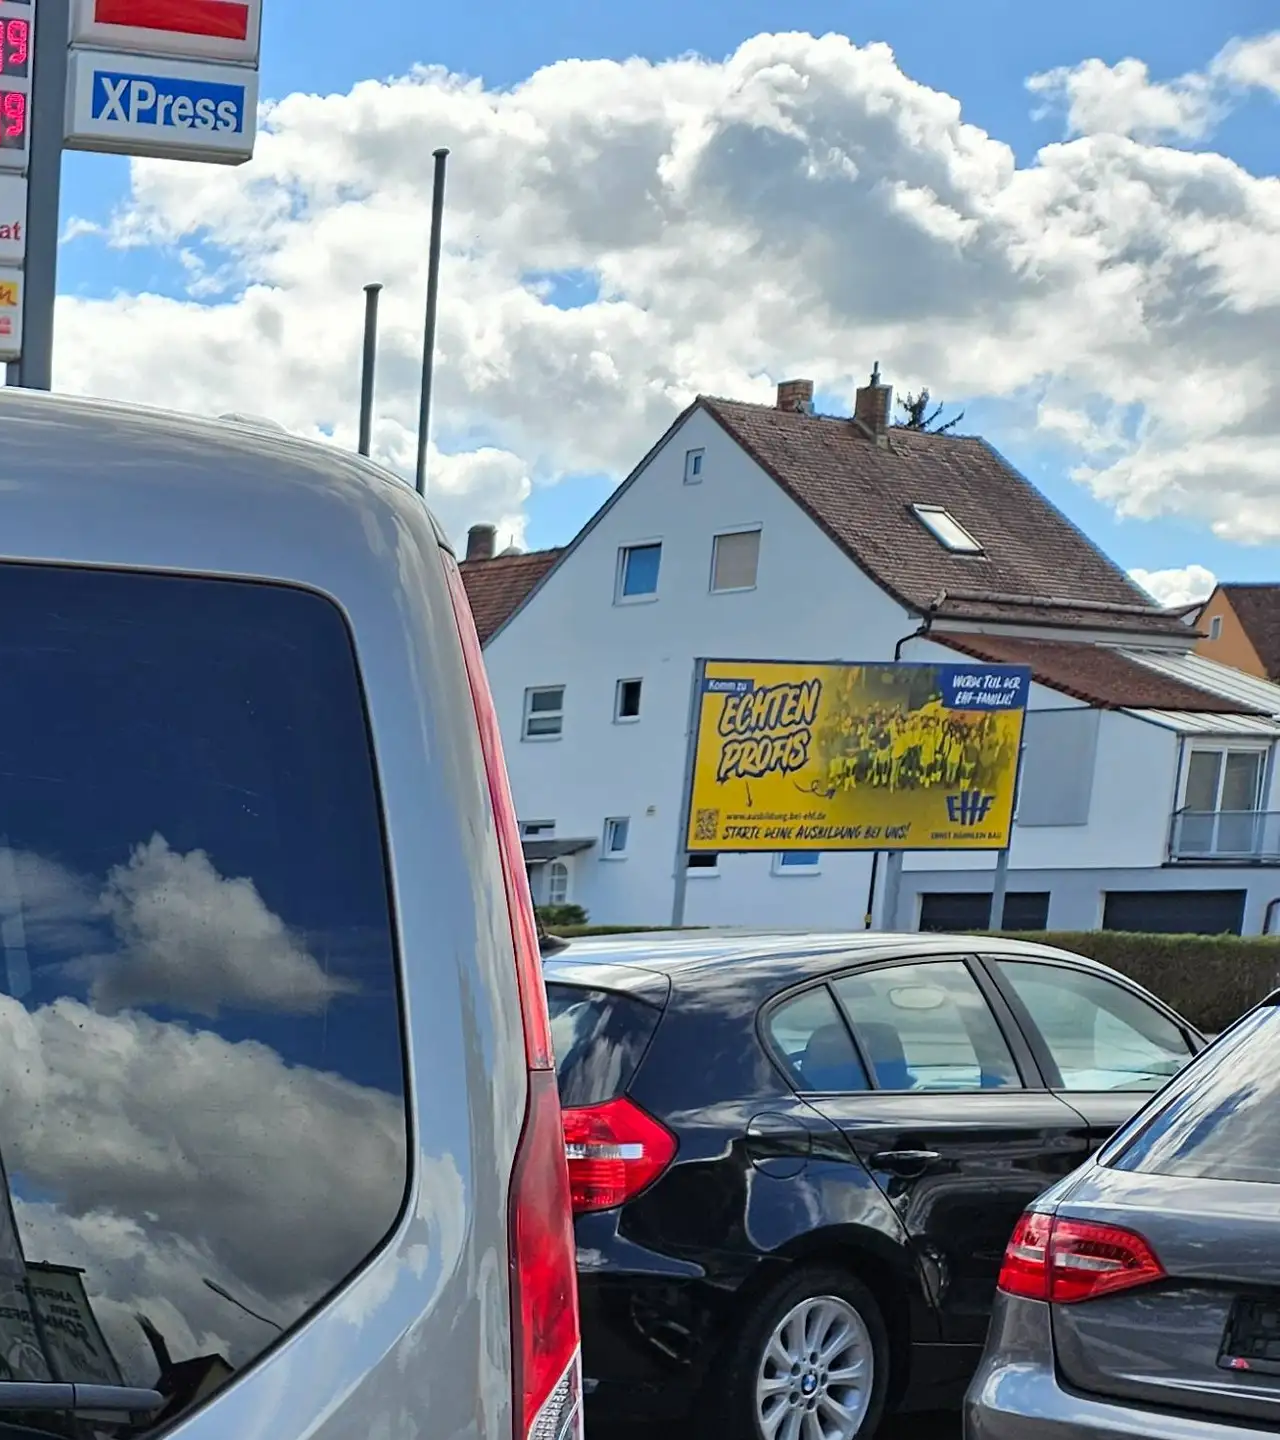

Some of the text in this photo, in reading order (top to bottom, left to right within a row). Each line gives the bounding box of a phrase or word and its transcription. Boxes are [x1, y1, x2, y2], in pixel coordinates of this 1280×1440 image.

[97, 77, 238, 133] XPress
[708, 680, 747, 692] Komm zu
[718, 678, 822, 737] ECHTEN
[716, 728, 811, 785] PROFIS
[722, 825, 760, 840] STARTE
